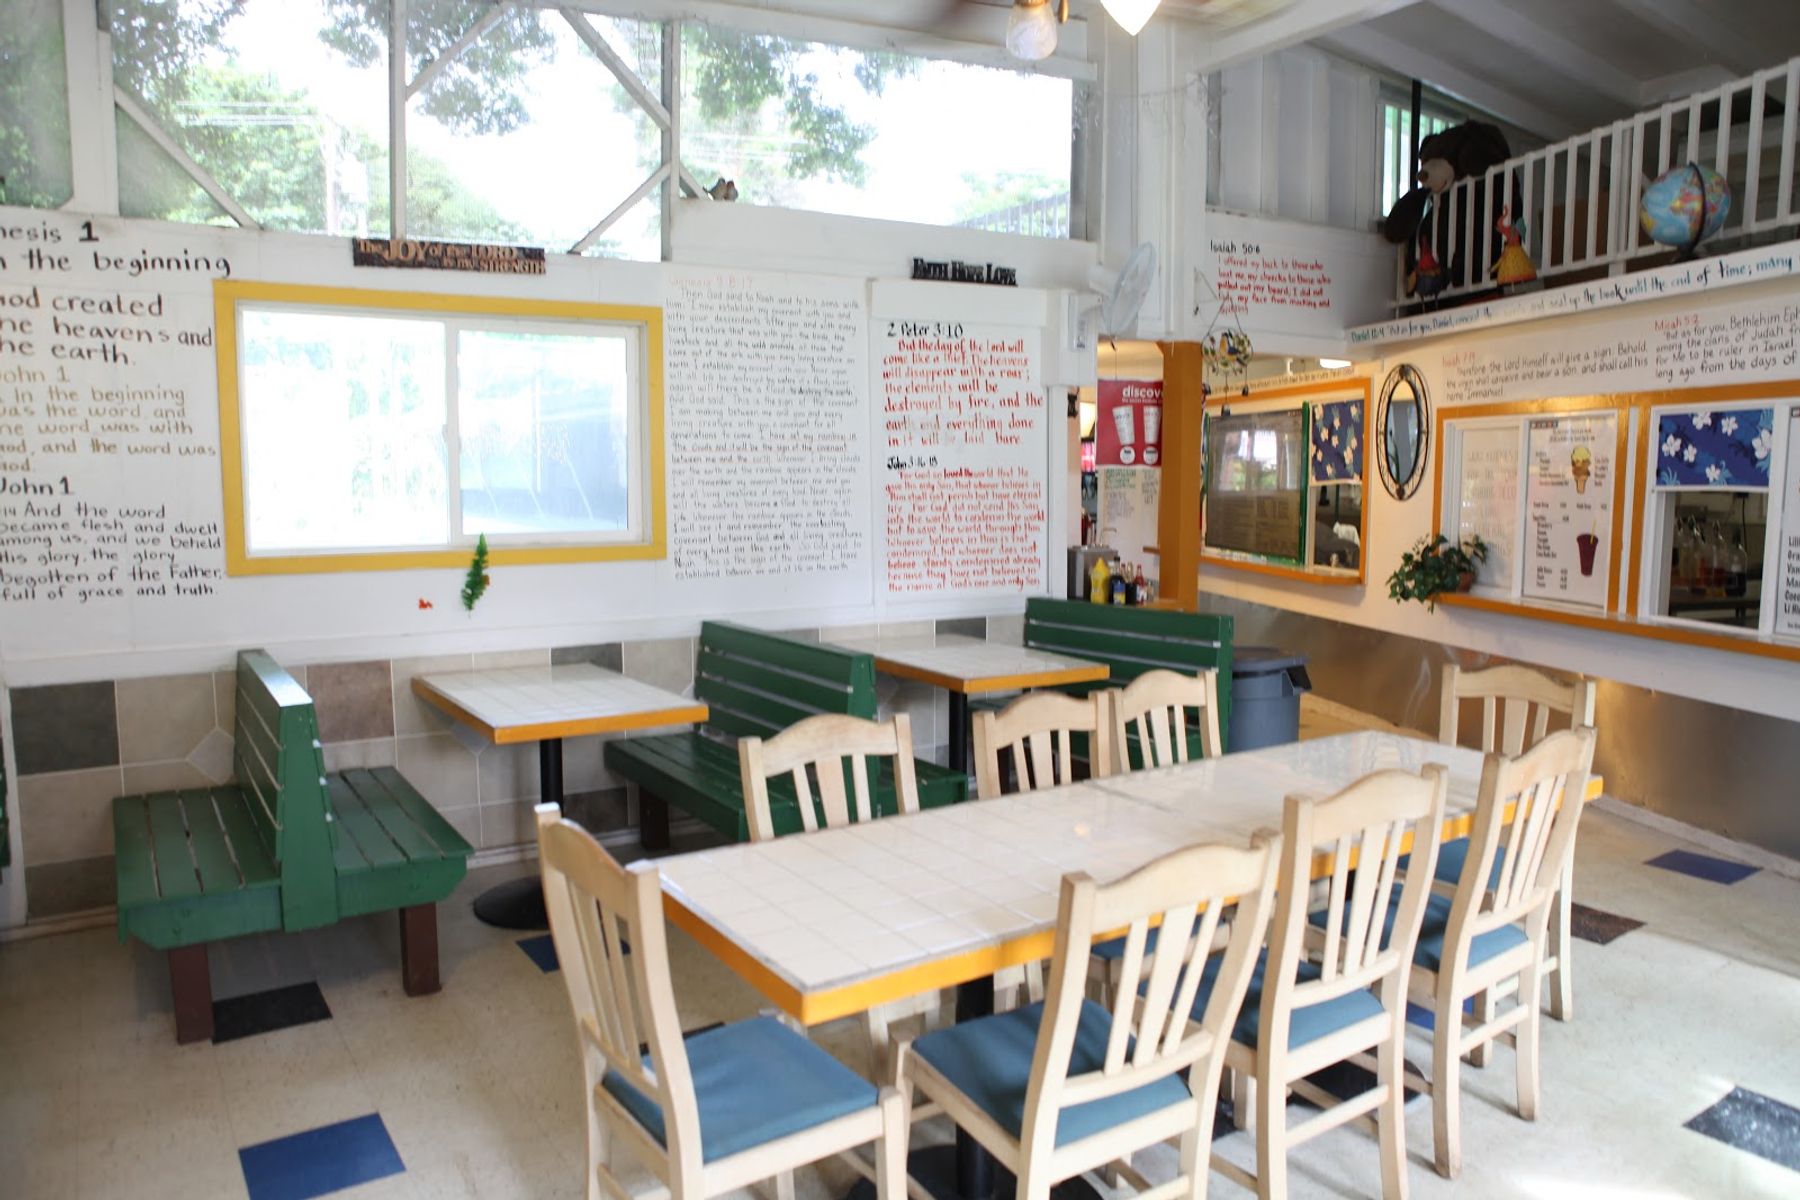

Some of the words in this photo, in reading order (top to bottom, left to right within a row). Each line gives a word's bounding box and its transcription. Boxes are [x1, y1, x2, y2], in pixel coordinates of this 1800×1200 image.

[79, 220, 99, 242] 1
[385, 240, 429, 262] JOY
[22, 248, 72, 271] the
[94, 249, 231, 277] beginning
[1697, 265, 1711, 287] of
[53, 294, 163, 317] created
[53, 316, 170, 344] heavens
[178, 328, 212, 347] and
[887, 322, 896, 337] 2
[901, 321, 929, 337] Peter
[1752, 325, 1784, 341] Judah
[1751, 356, 1777, 371] days
[1783, 350, 1798, 367] of
[48, 385, 78, 401] the
[91, 384, 185, 406] beginning
[46, 403, 77, 418] the
[88, 404, 140, 418] word
[153, 405, 186, 418] and
[38, 418, 89, 434] word
[101, 423, 139, 433] was
[149, 419, 193, 434] with
[42, 439, 77, 453] and
[90, 438, 117, 453] the
[127, 441, 170, 456] word
[179, 445, 216, 456] was
[60, 475, 74, 495] 1
[25, 501, 61, 517] And
[76, 501, 108, 517] the
[119, 504, 165, 519] word
[82, 519, 124, 531] flesh
[135, 523, 165, 533] and
[175, 521, 218, 535] dwelt
[97, 533, 128, 544] and
[135, 537, 161, 546] we
[92, 548, 118, 560] the
[133, 549, 175, 564] glory
[97, 566, 118, 581] of
[128, 565, 160, 581] the
[3, 587, 36, 600] full
[47, 584, 67, 600] of
[79, 588, 124, 604] grace
[137, 584, 166, 596] and
